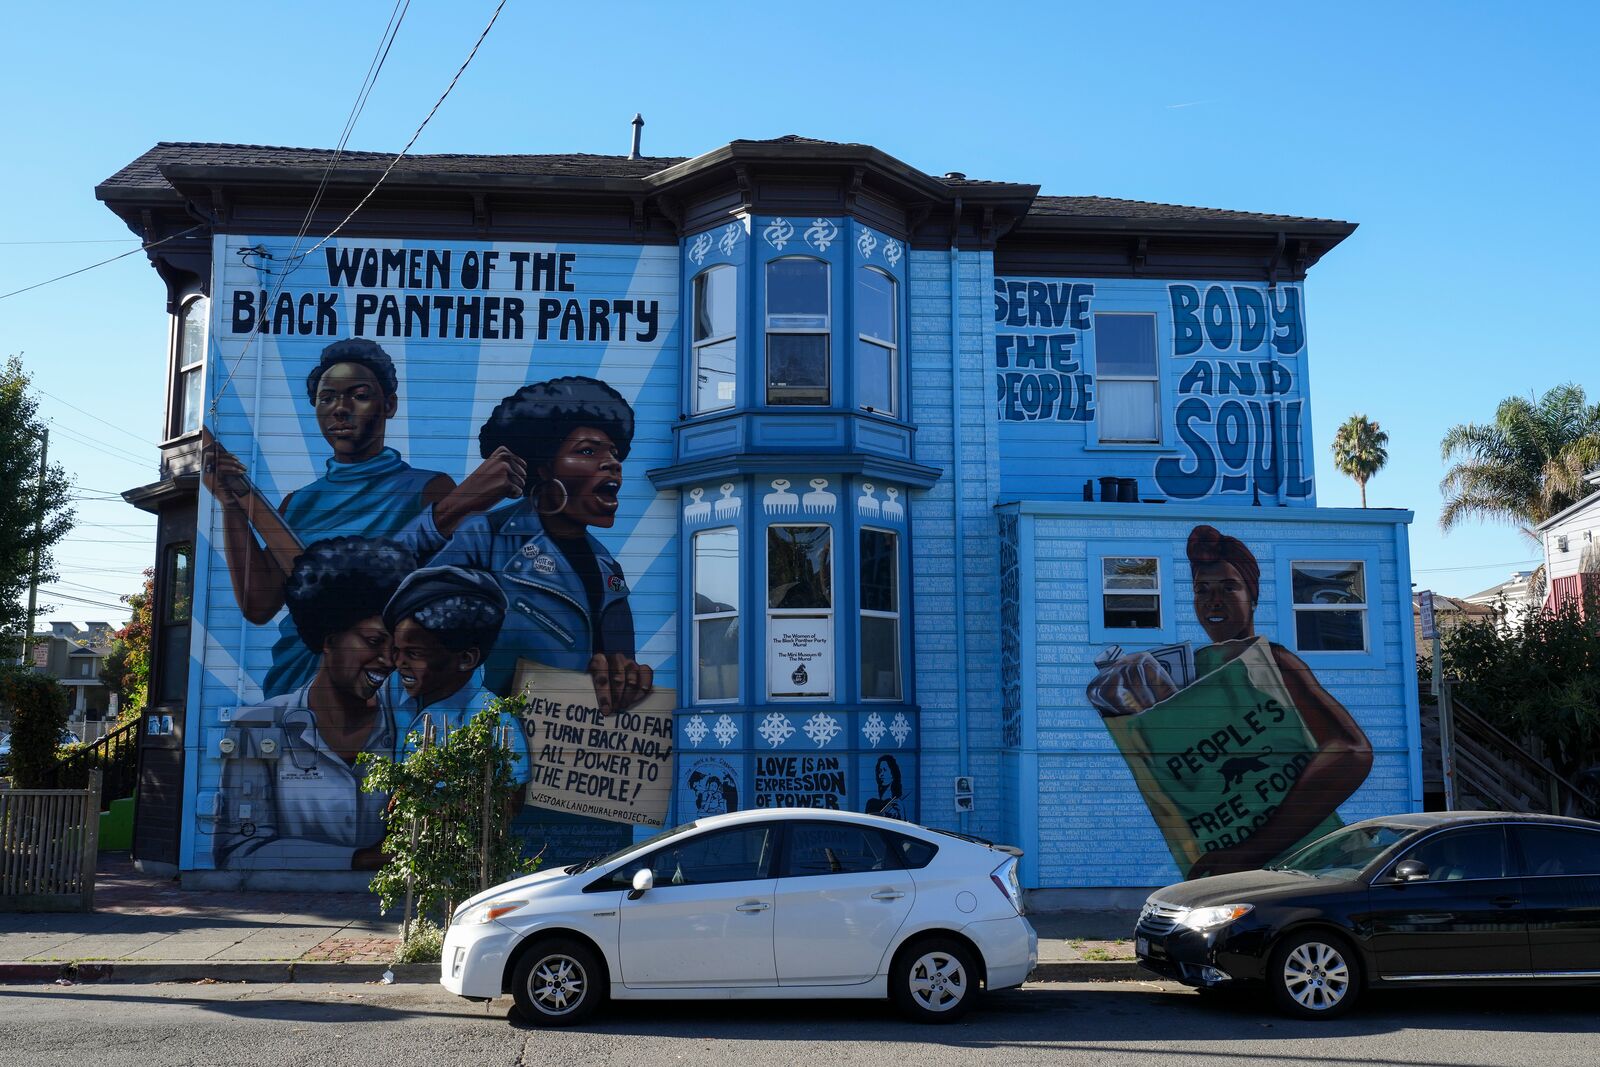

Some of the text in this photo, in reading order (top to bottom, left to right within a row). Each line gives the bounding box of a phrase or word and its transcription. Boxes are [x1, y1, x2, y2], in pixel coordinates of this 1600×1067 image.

[325, 247, 576, 292] WOMEN OF THE
[232, 290, 659, 342] BLACK PANTHER PARTY
[994, 279, 1095, 330] SERVE
[1167, 284, 1304, 356] BODY
[995, 333, 1080, 373] THE
[1178, 360, 1292, 396] AND
[1154, 397, 1313, 500] SOUL
[521, 697, 672, 740] WE'VE COME TOO FAR
[543, 721, 584, 745] TURN
[588, 728, 628, 752] BACK
[631, 737, 672, 762] NOW
[1166, 699, 1285, 781] PEOPLE'S
[533, 764, 563, 789] THE
[539, 744, 565, 765] ALL
[573, 748, 631, 776] POWER
[637, 759, 658, 782] TO
[755, 771, 846, 796] EXPRESSION
[756, 757, 797, 777] LOVE
[802, 757, 814, 774] IS
[817, 757, 839, 771] AN
[756, 793, 840, 810] OF POWER
[1187, 794, 1250, 838] FREE
[1255, 754, 1309, 802] FOOD
